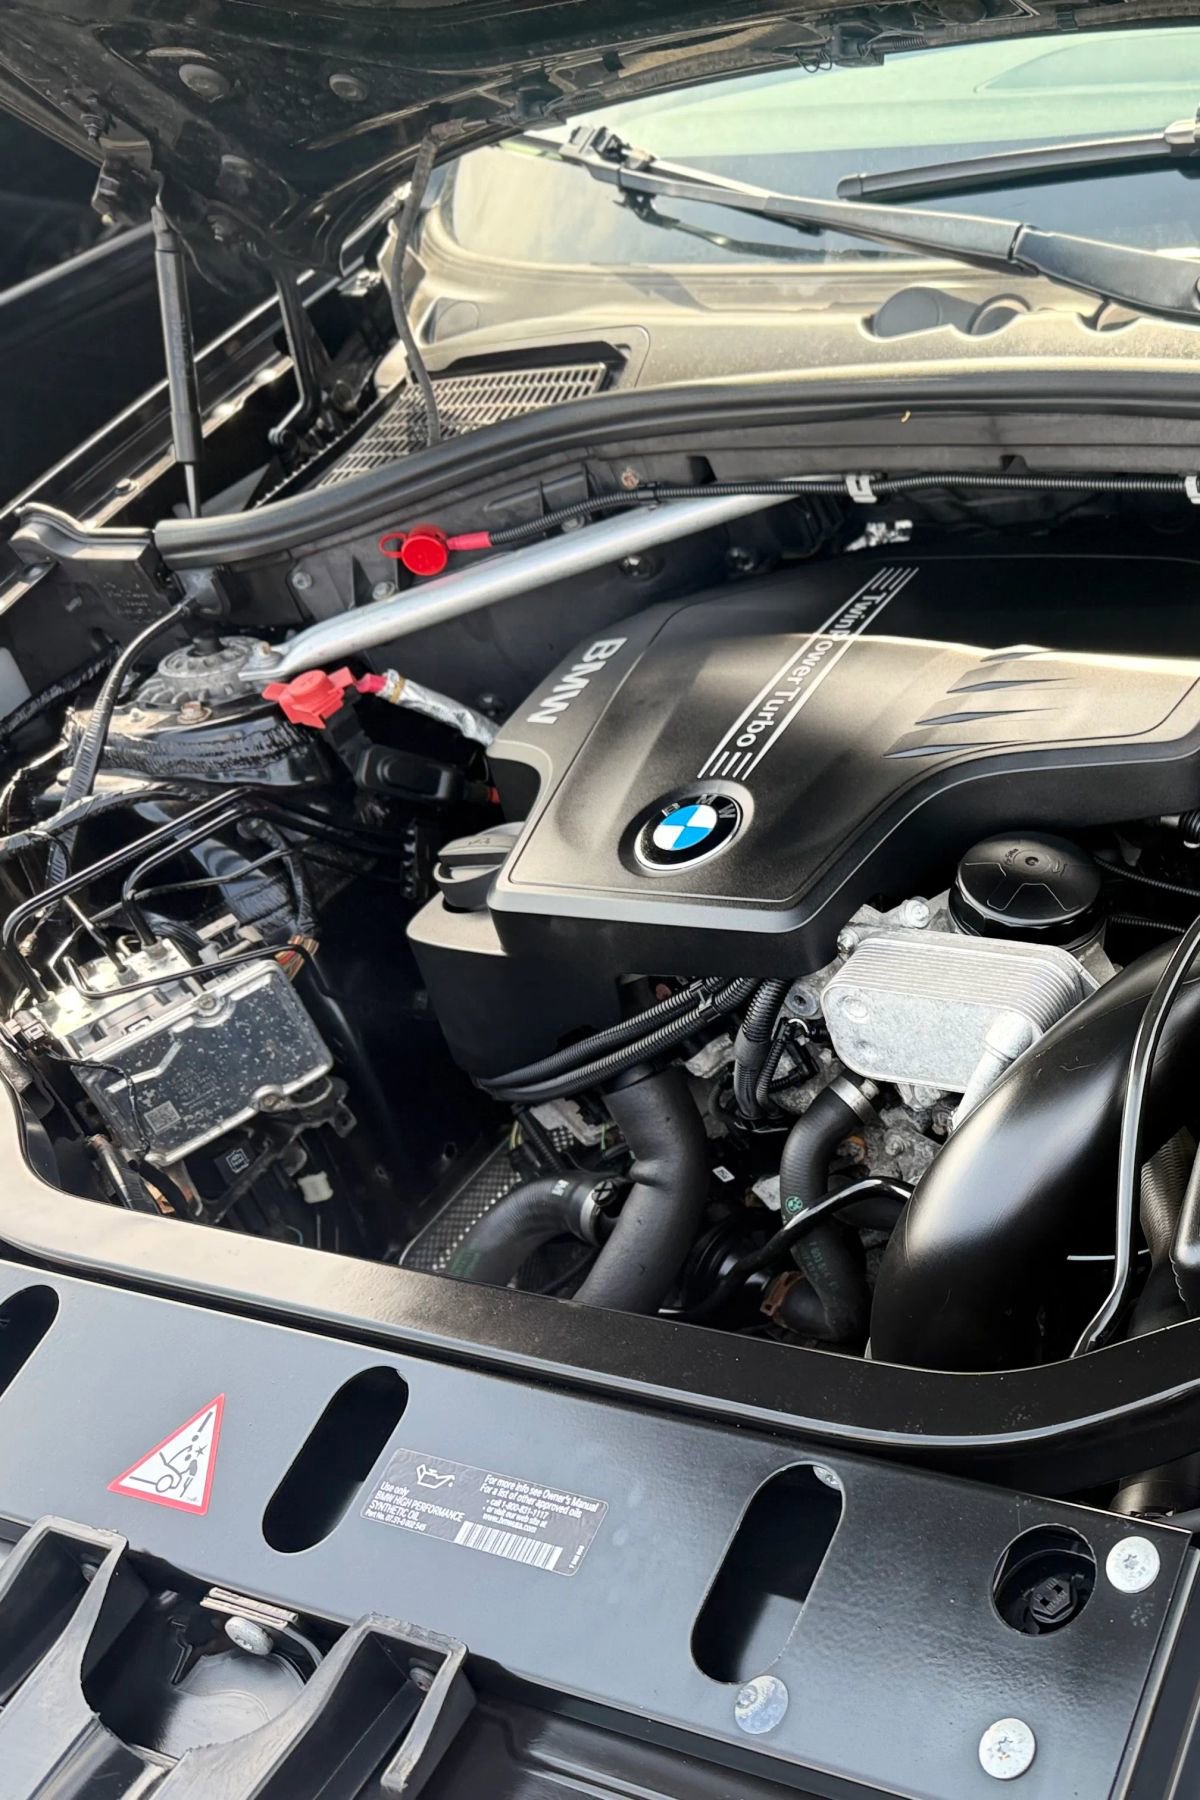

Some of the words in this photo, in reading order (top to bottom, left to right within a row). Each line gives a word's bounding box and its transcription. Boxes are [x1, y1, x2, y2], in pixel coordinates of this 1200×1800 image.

[527, 637, 628, 725] BMW
[381, 1482, 394, 1492] Use
[394, 1485, 410, 1497] only
[480, 1484, 492, 1493] For
[498, 1489, 509, 1498] list
[508, 1492, 517, 1500] of
[517, 1494, 535, 1505] other
[535, 1499, 569, 1515] approved
[568, 1508, 582, 1518] oils
[484, 1475, 497, 1484] For
[497, 1480, 514, 1489] more
[515, 1483, 530, 1493] info
[529, 1489, 542, 1497] see
[542, 1490, 570, 1504] Owner's
[571, 1497, 599, 1512] Manual
[369, 1500, 409, 1517] SYNTHETIC
[407, 1511, 420, 1520] OIL
[375, 1491, 395, 1503] BMW
[394, 1496, 412, 1508] HIGH
[411, 1500, 465, 1522] PERFORMANCE
